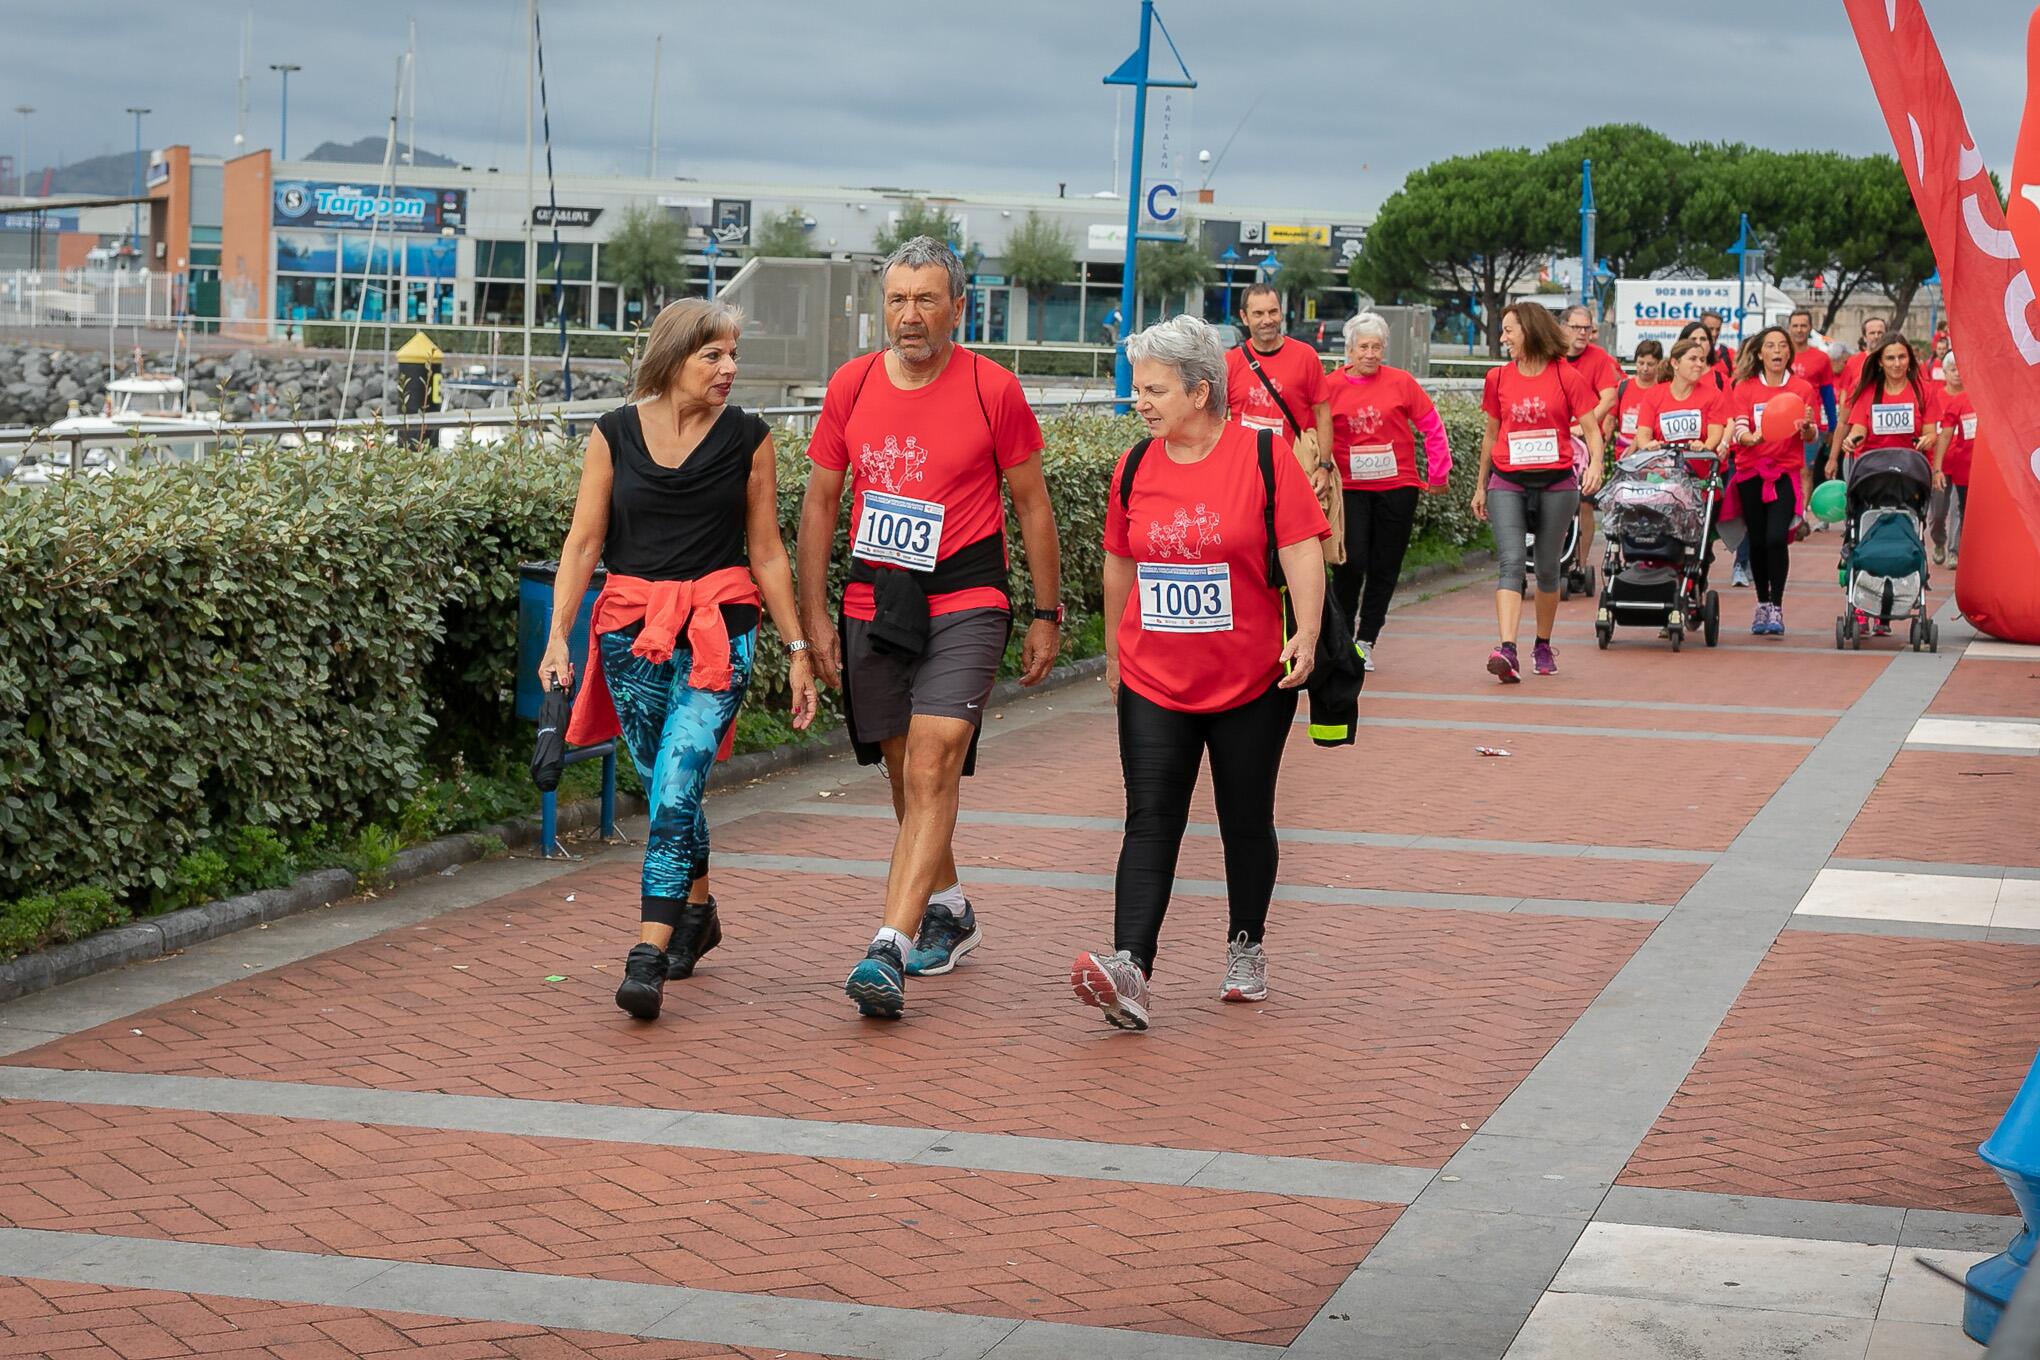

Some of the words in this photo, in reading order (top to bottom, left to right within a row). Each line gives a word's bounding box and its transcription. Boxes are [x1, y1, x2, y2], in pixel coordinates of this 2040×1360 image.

[1160, 94, 1172, 169] PANTALAN
[315, 190, 424, 219] Tarpoon
[1147, 184, 1178, 221] C
[1655, 287, 1677, 296] 902
[1680, 287, 1694, 296] 88
[1697, 287, 1711, 296] 99
[1746, 292, 1760, 307] A
[1665, 417, 1697, 433] 1008
[1878, 412, 1910, 427] 1008
[1513, 440, 1554, 455] 3020
[1354, 456, 1391, 468] 3020
[868, 512, 932, 553] 1003
[1150, 582, 1222, 616] 1003
